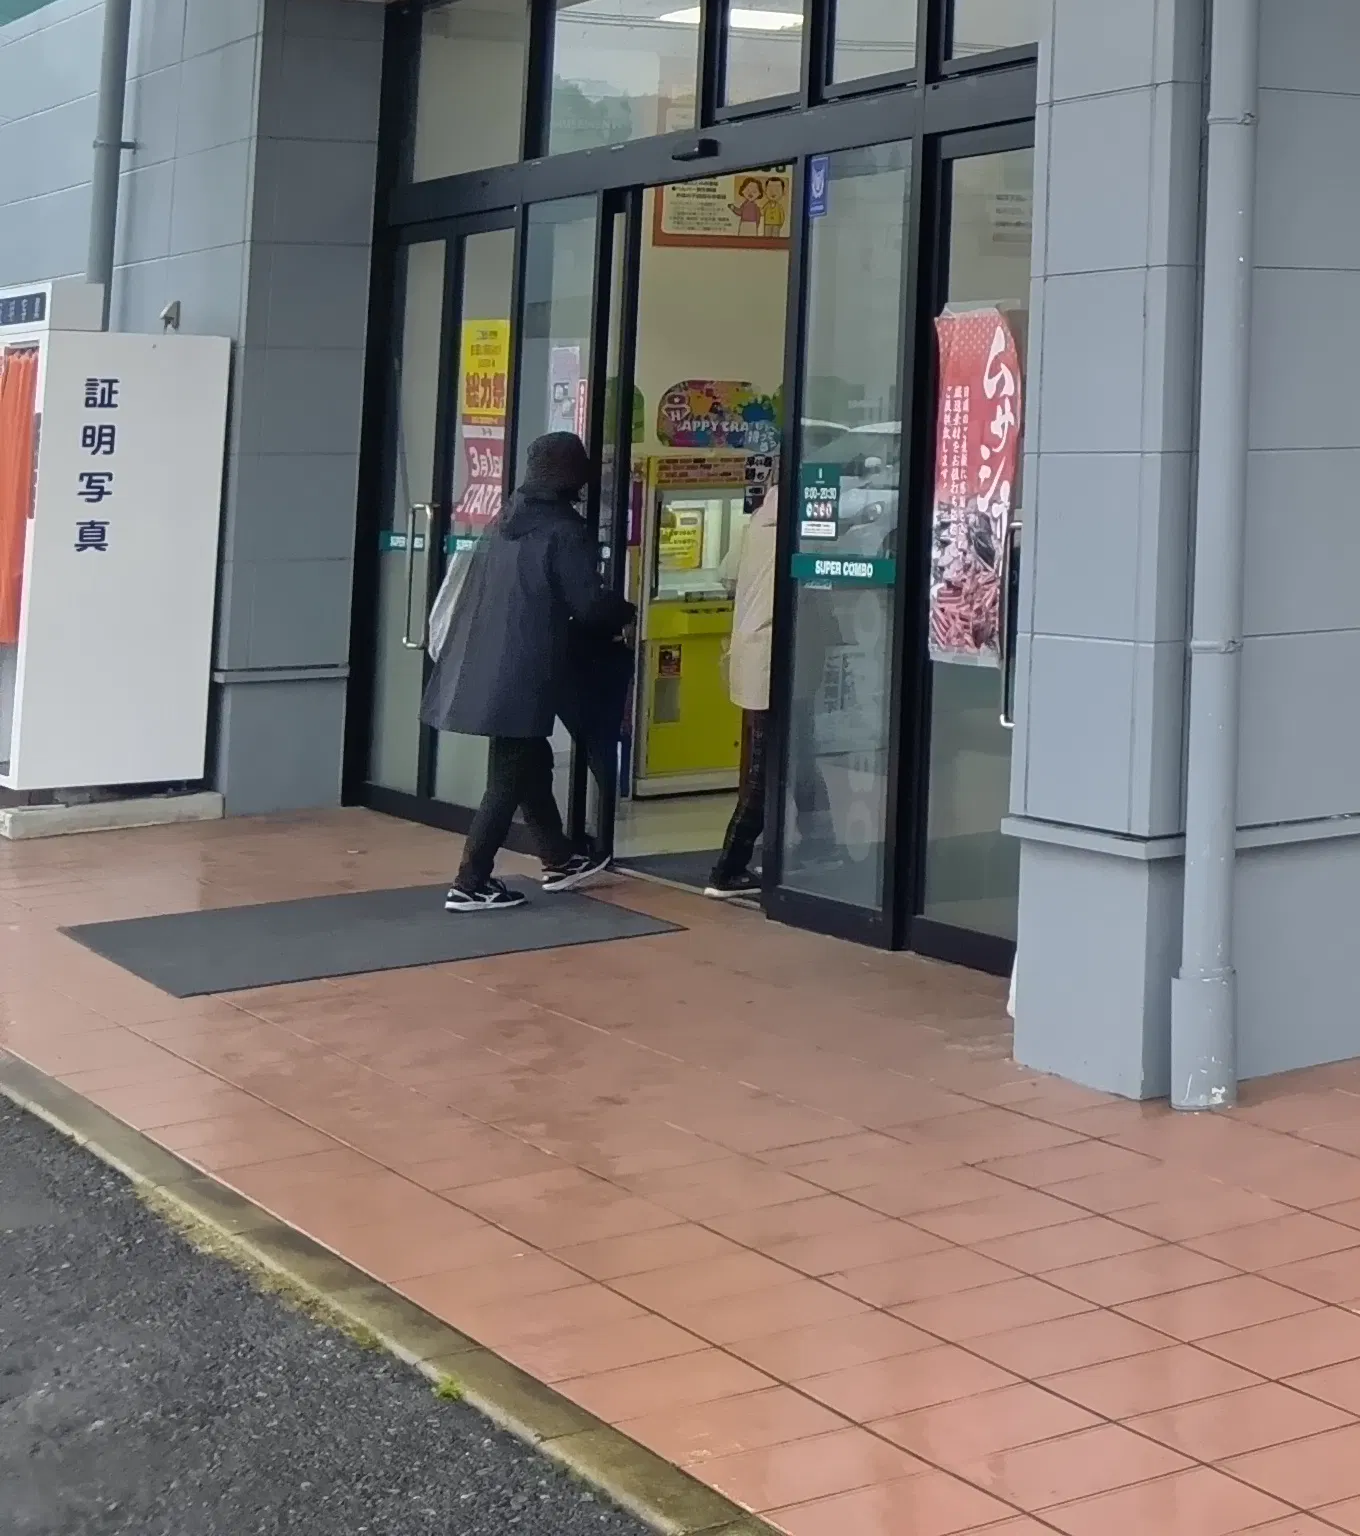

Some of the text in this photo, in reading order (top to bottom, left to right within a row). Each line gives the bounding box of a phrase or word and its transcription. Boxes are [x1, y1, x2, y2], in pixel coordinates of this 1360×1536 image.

[74, 377, 120, 553] 証明写真
[815, 560, 874, 578] SUPER COMBO
